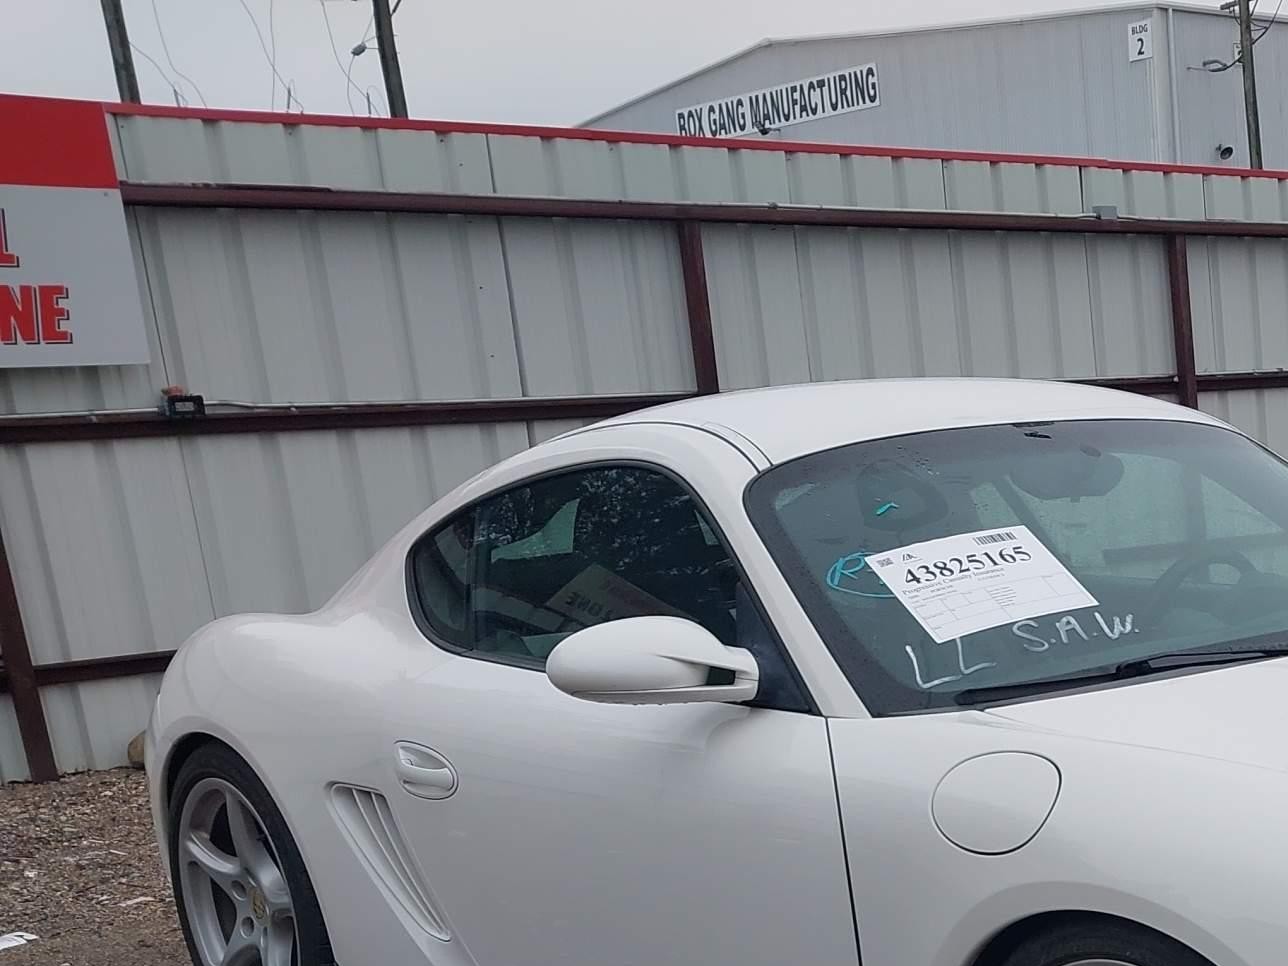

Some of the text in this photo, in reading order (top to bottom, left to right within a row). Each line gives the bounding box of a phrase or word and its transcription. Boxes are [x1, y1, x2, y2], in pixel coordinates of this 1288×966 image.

[1131, 24, 1148, 35] BLDG
[1137, 37, 1145, 56] 2
[677, 67, 878, 138] BOX GANG MANUFACTURING
[904, 546, 1032, 584] 43825165
